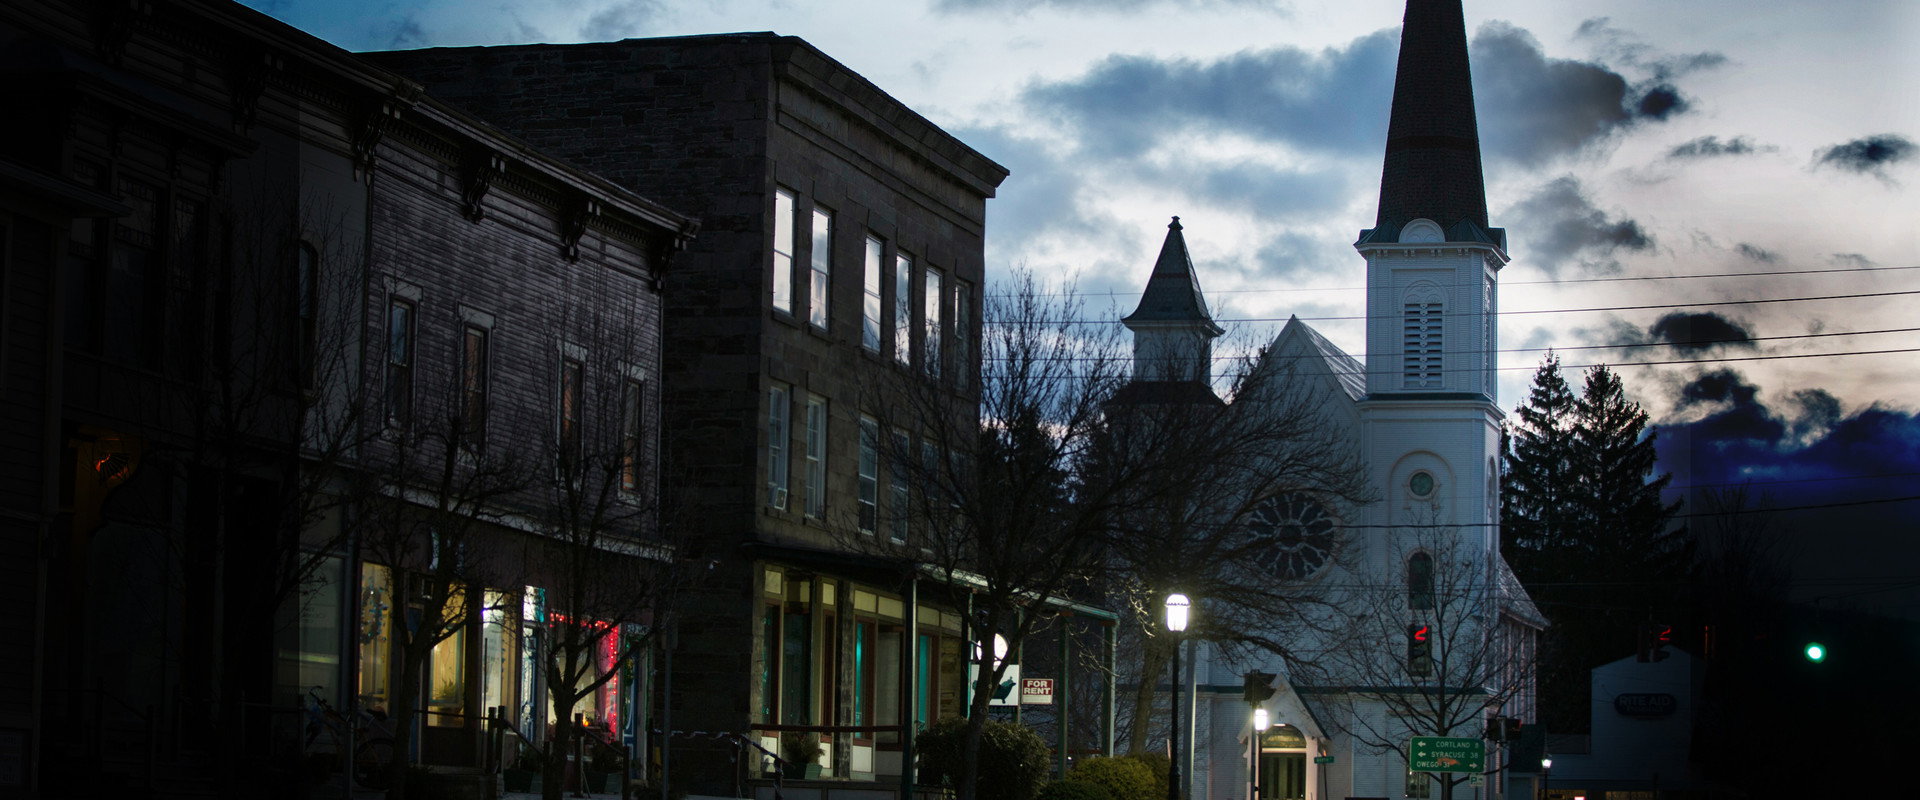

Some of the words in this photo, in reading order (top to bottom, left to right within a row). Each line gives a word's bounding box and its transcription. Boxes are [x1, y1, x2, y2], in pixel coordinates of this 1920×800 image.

[1026, 680, 1048, 688] FOR
[1023, 687, 1051, 695] RENT
[1435, 741, 1471, 749] CORTLAND
[1431, 751, 1466, 759] SYRACUSE
[1470, 751, 1479, 759] 38
